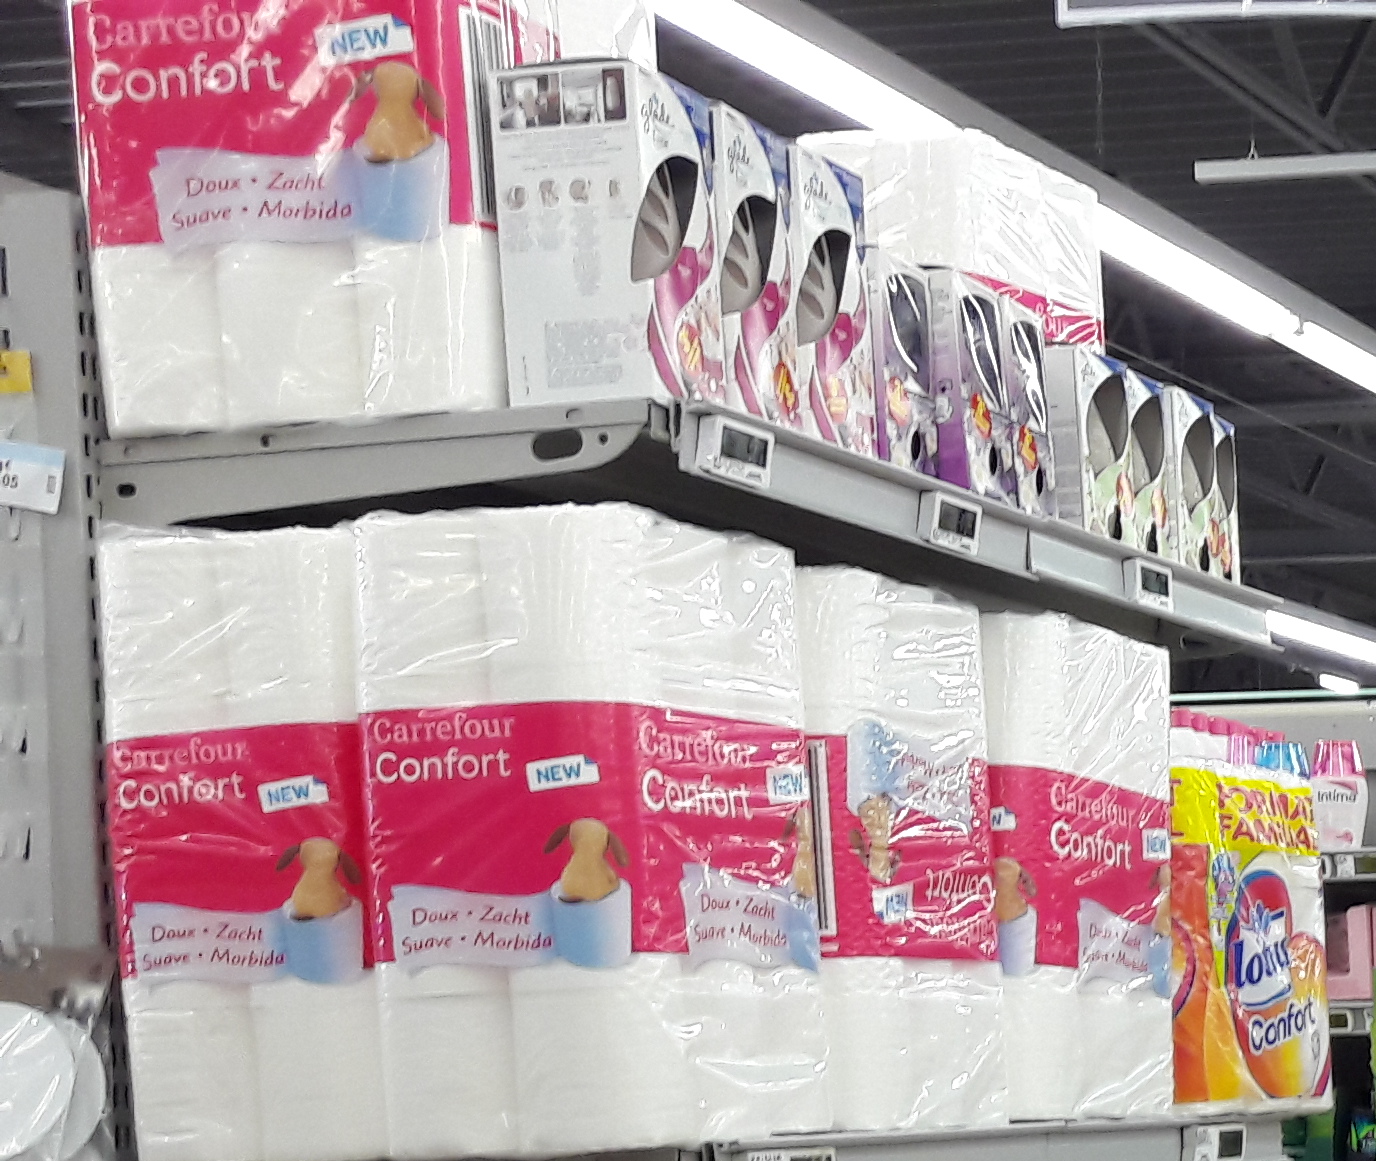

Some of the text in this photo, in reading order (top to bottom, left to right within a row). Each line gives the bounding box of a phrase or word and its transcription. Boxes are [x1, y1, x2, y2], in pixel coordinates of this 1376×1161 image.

[329, 26, 391, 56] NEW
[90, 52, 284, 104] Confort
[185, 174, 241, 198] Doux
[372, 714, 516, 744] Carrefour
[113, 740, 250, 772] Carrefour
[375, 747, 512, 784] Confort
[534, 760, 583, 784] NEW
[118, 773, 246, 812] Confort
[265, 783, 311, 806] NEW
[641, 767, 753, 820] Confort
[1050, 819, 1132, 870] Confort
[411, 907, 531, 926] Doux Zacht
[701, 893, 731, 913] Doux
[151, 922, 264, 943] Doux Zacht
[402, 934, 453, 955] Suave
[142, 951, 190, 971] Suave
[1249, 999, 1316, 1056] Confort
